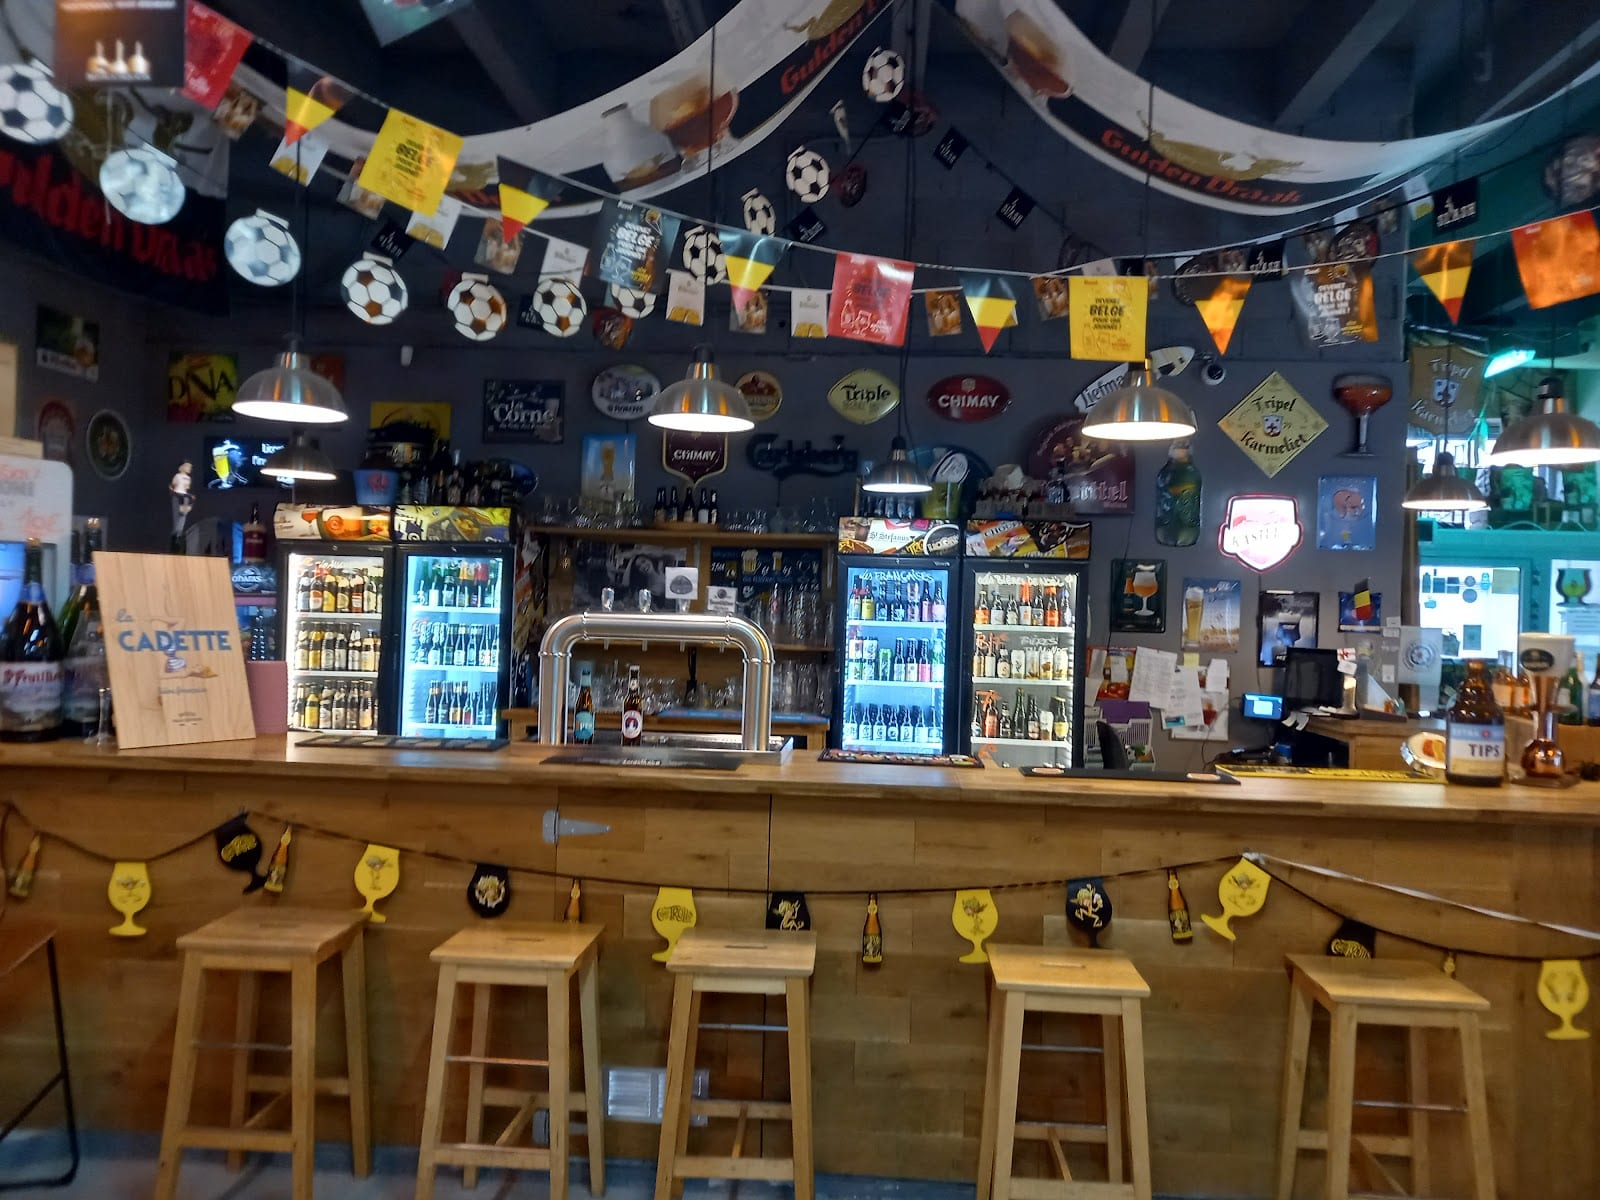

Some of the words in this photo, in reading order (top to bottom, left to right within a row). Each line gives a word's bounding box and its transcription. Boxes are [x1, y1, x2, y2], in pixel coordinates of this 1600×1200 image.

[1102, 129, 1201, 186] Gulden
[1206, 175, 1300, 204] Draak
[1089, 305, 1126, 317] BELGE
[841, 384, 891, 402] Triple
[938, 394, 999, 409] CHIMAY
[1251, 396, 1297, 412] Tripel
[1240, 431, 1307, 454] Karmeliet
[118, 630, 232, 652] CADETTE
[1468, 743, 1500, 757] TIPS
